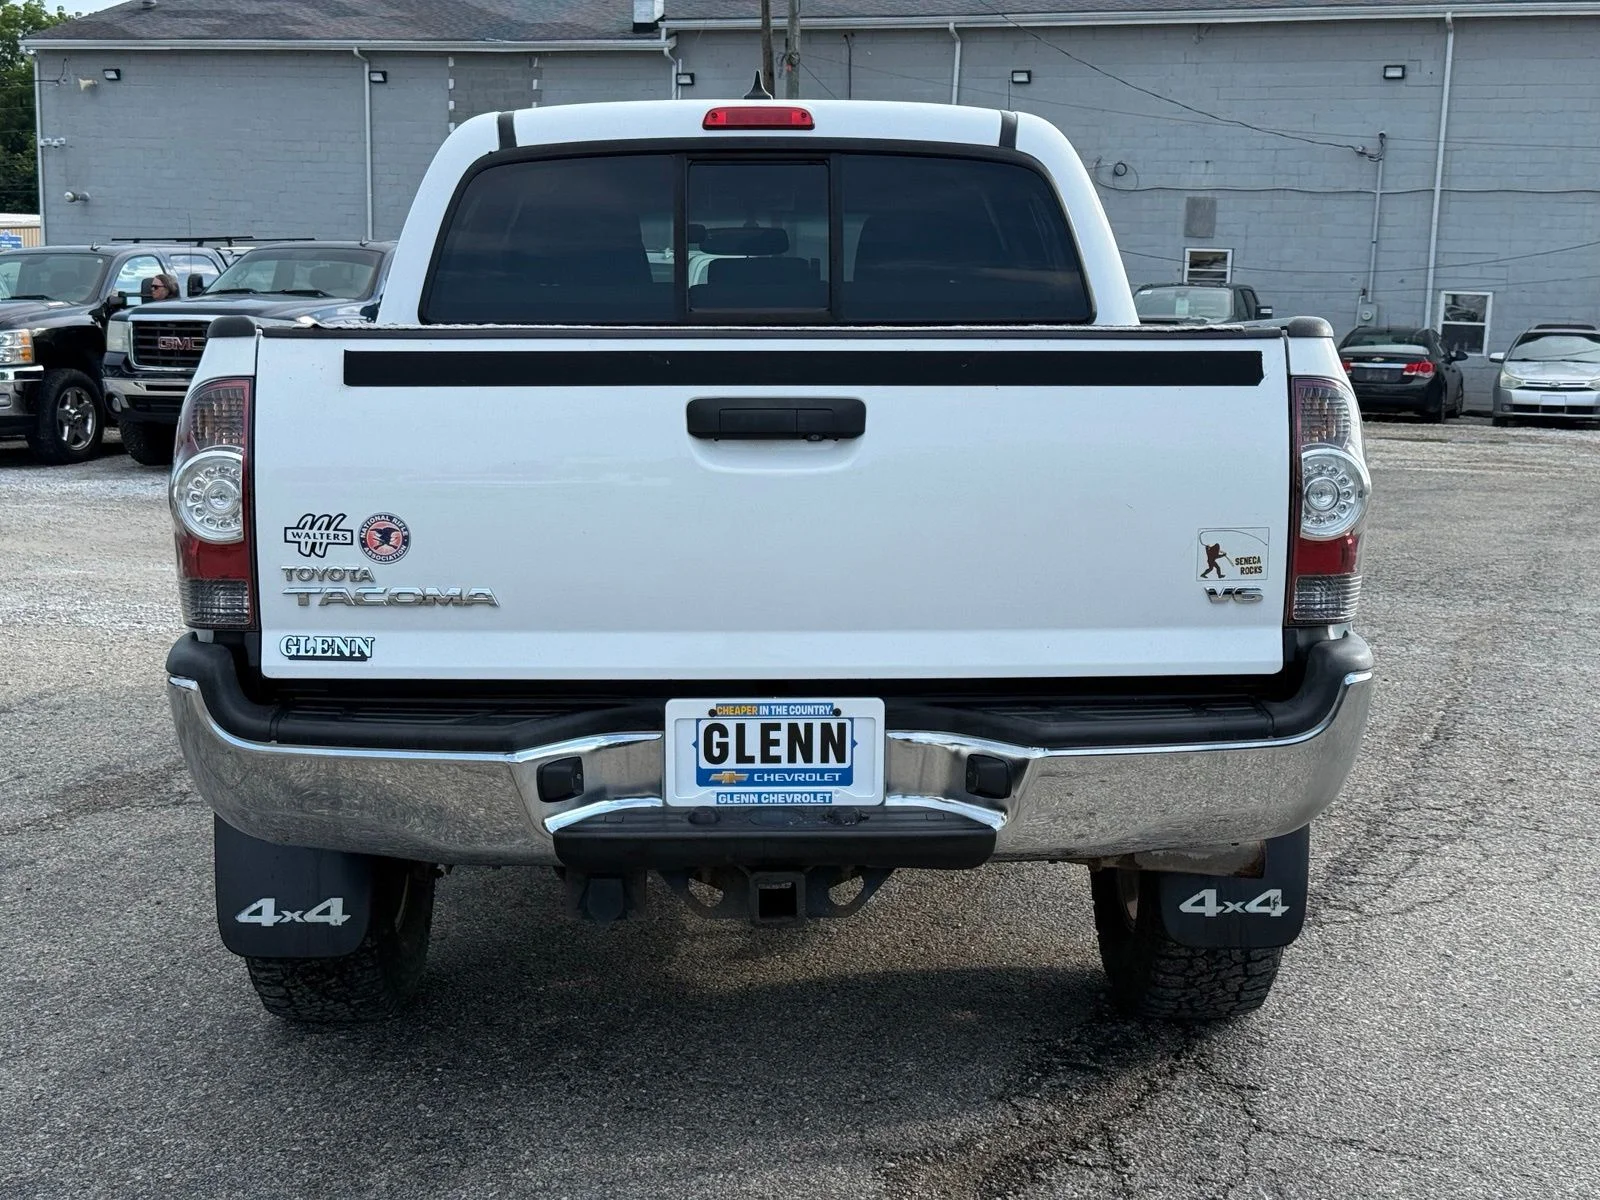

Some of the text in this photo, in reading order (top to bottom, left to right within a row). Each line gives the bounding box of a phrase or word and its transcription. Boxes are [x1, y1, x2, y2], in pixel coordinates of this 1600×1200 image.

[159, 336, 206, 351] GMC
[360, 515, 409, 539] NATIONAL RIFLE
[291, 531, 348, 541] WALTERS
[363, 544, 407, 561] ASSOCIATION
[1234, 556, 1262, 566] SENECA
[281, 566, 375, 583] TOYOTA
[1240, 566, 1263, 575] ROCKS
[282, 587, 499, 607] TACOMA
[1204, 587, 1264, 604] V6
[279, 635, 375, 659] GLENN
[716, 704, 833, 716] CHEAPER IN THE COUNTRY.
[703, 722, 847, 765] GLENN
[753, 773, 842, 782] CHEVROLET
[718, 793, 832, 804] GLENN CHEVROLET
[1179, 888, 1290, 917] 4x4
[235, 897, 351, 927] 4x4
